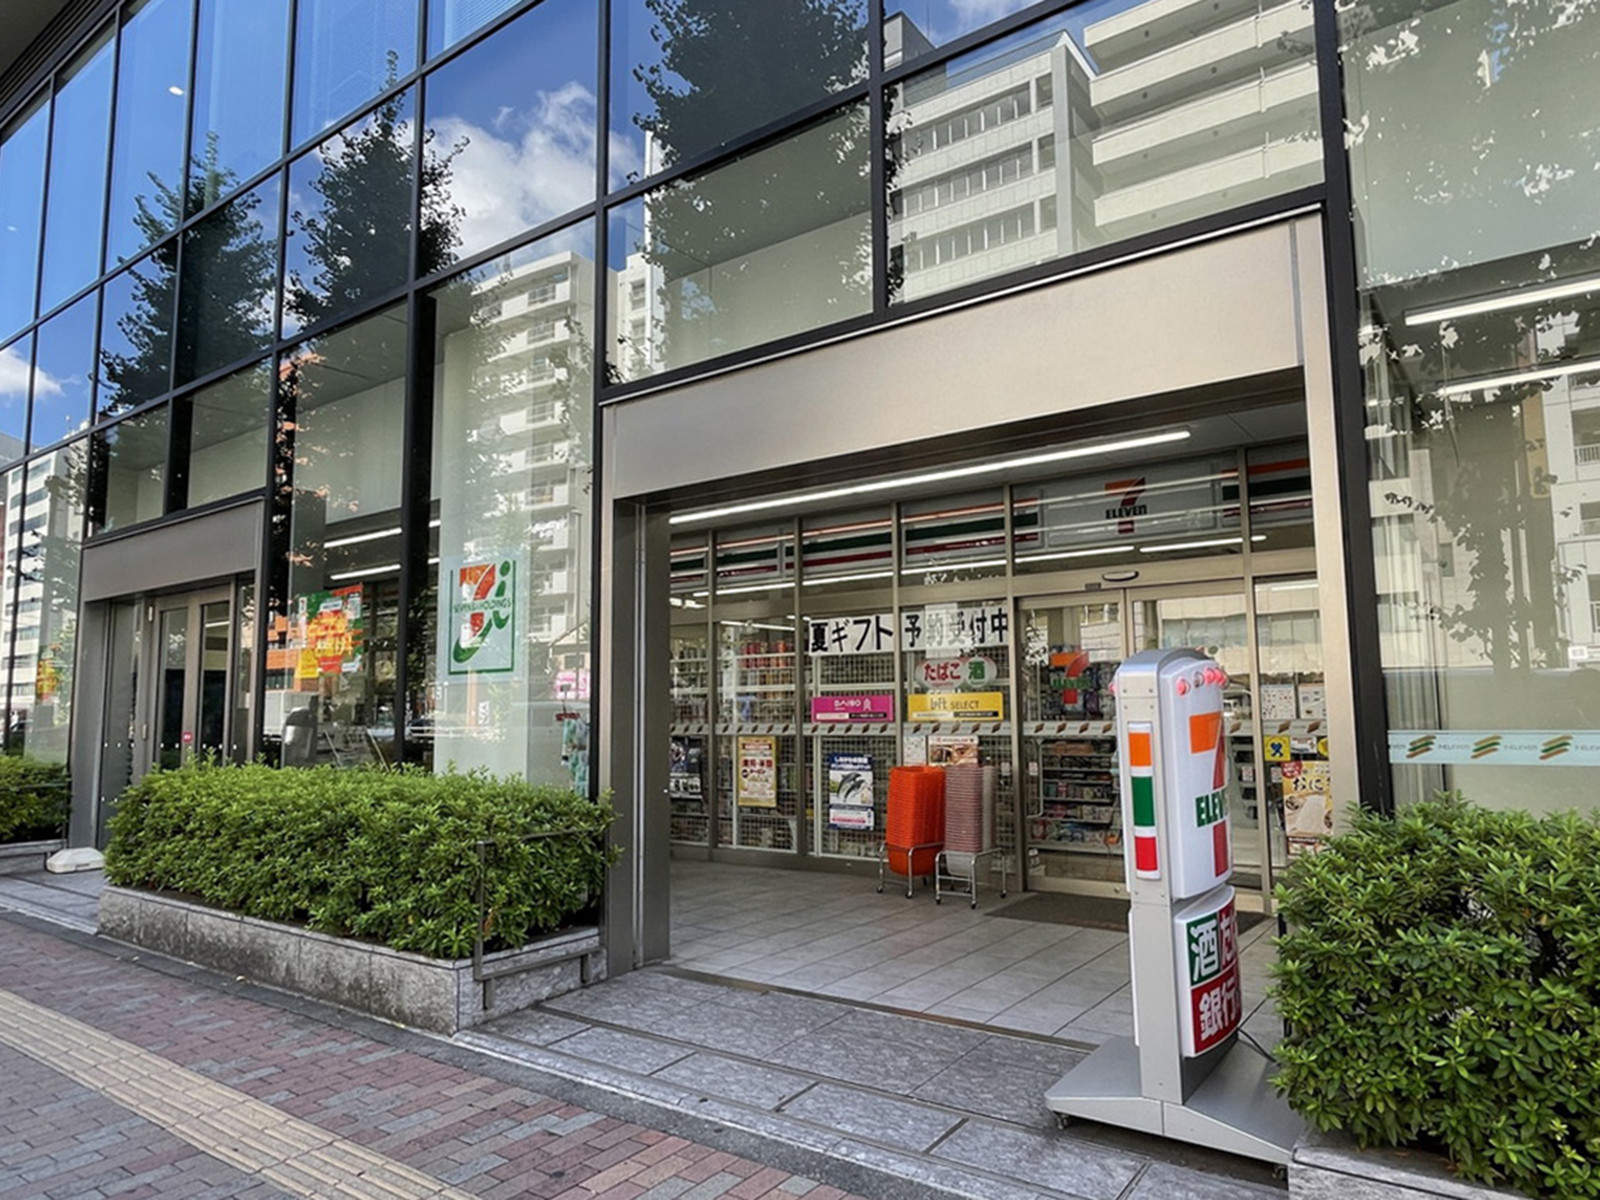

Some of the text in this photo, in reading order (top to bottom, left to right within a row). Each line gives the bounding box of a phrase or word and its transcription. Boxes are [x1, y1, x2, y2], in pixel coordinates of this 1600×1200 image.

[810, 607, 1009, 652] 夏ギフト 予約受付中
[924, 661, 986, 681] たばこ 酒
[950, 700, 980, 710] SELECT
[1189, 919, 1220, 982] 酒
